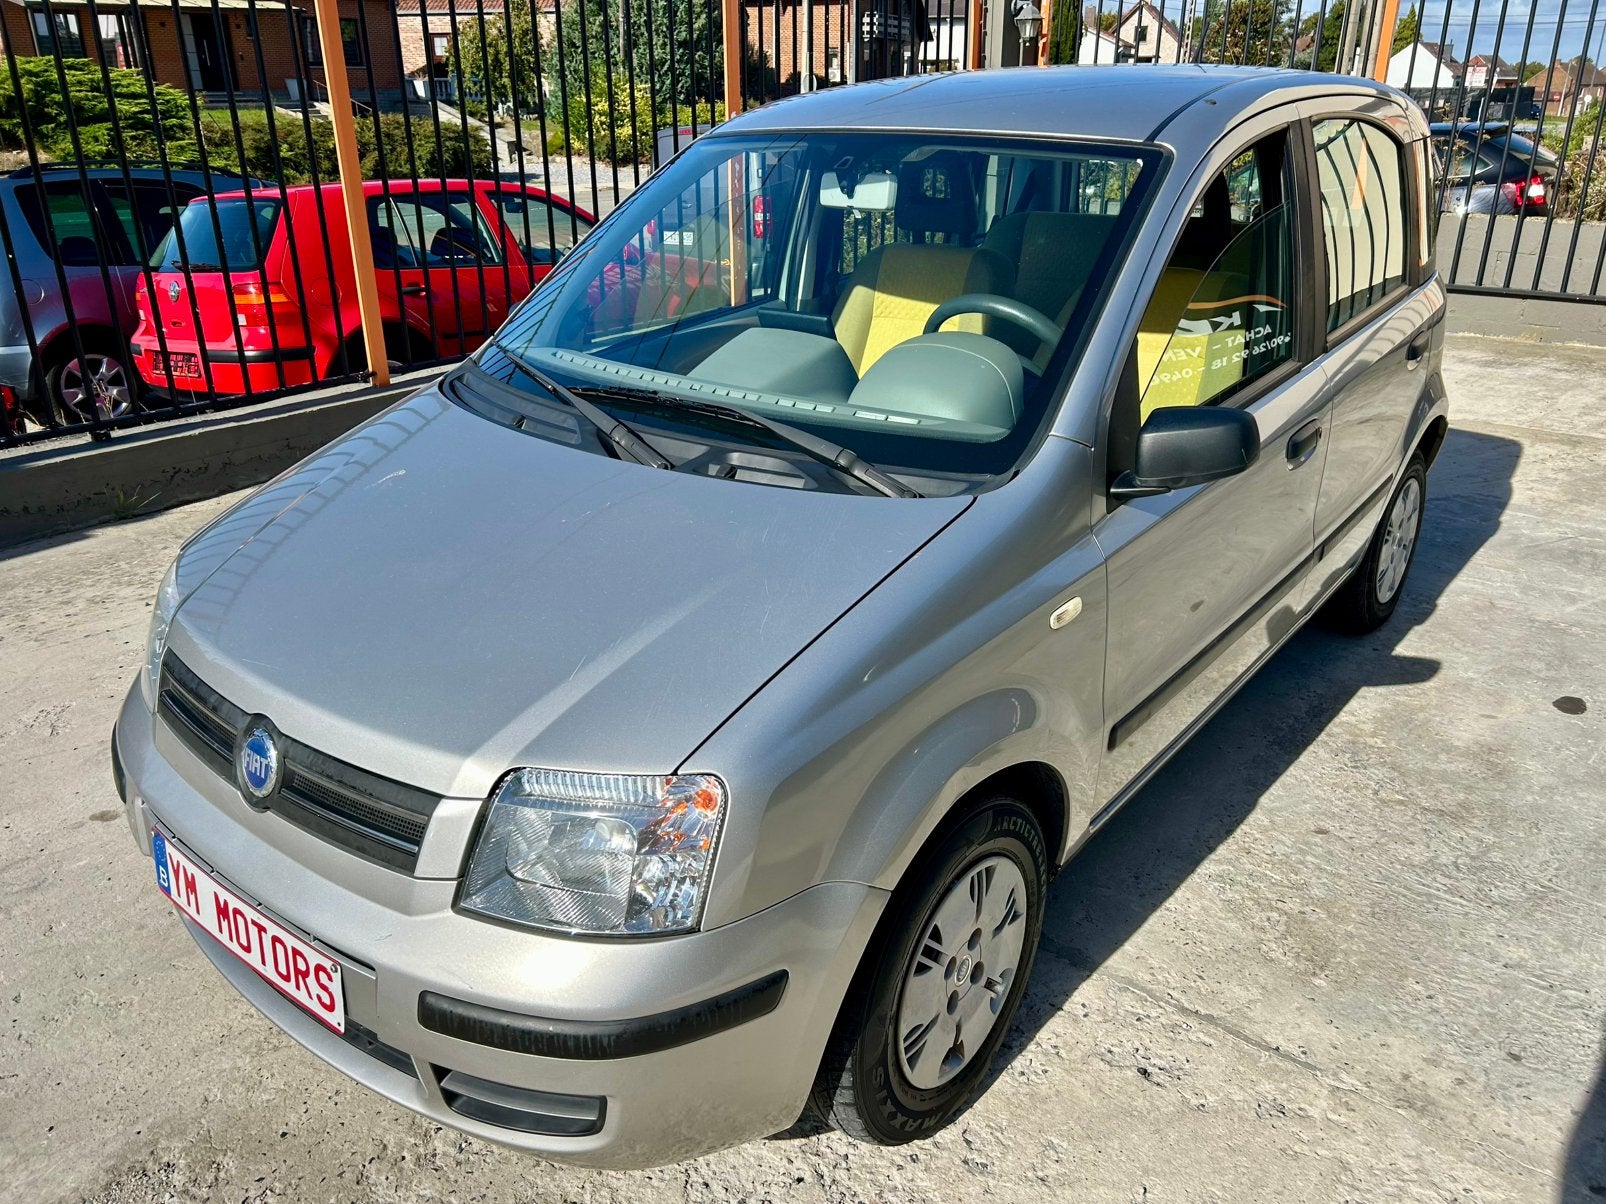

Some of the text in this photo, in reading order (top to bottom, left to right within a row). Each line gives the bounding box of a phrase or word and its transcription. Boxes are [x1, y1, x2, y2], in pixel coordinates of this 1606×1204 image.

[244, 746, 270, 779] FIAT
[159, 865, 169, 888] B
[168, 851, 337, 1013] YM MOTORS
